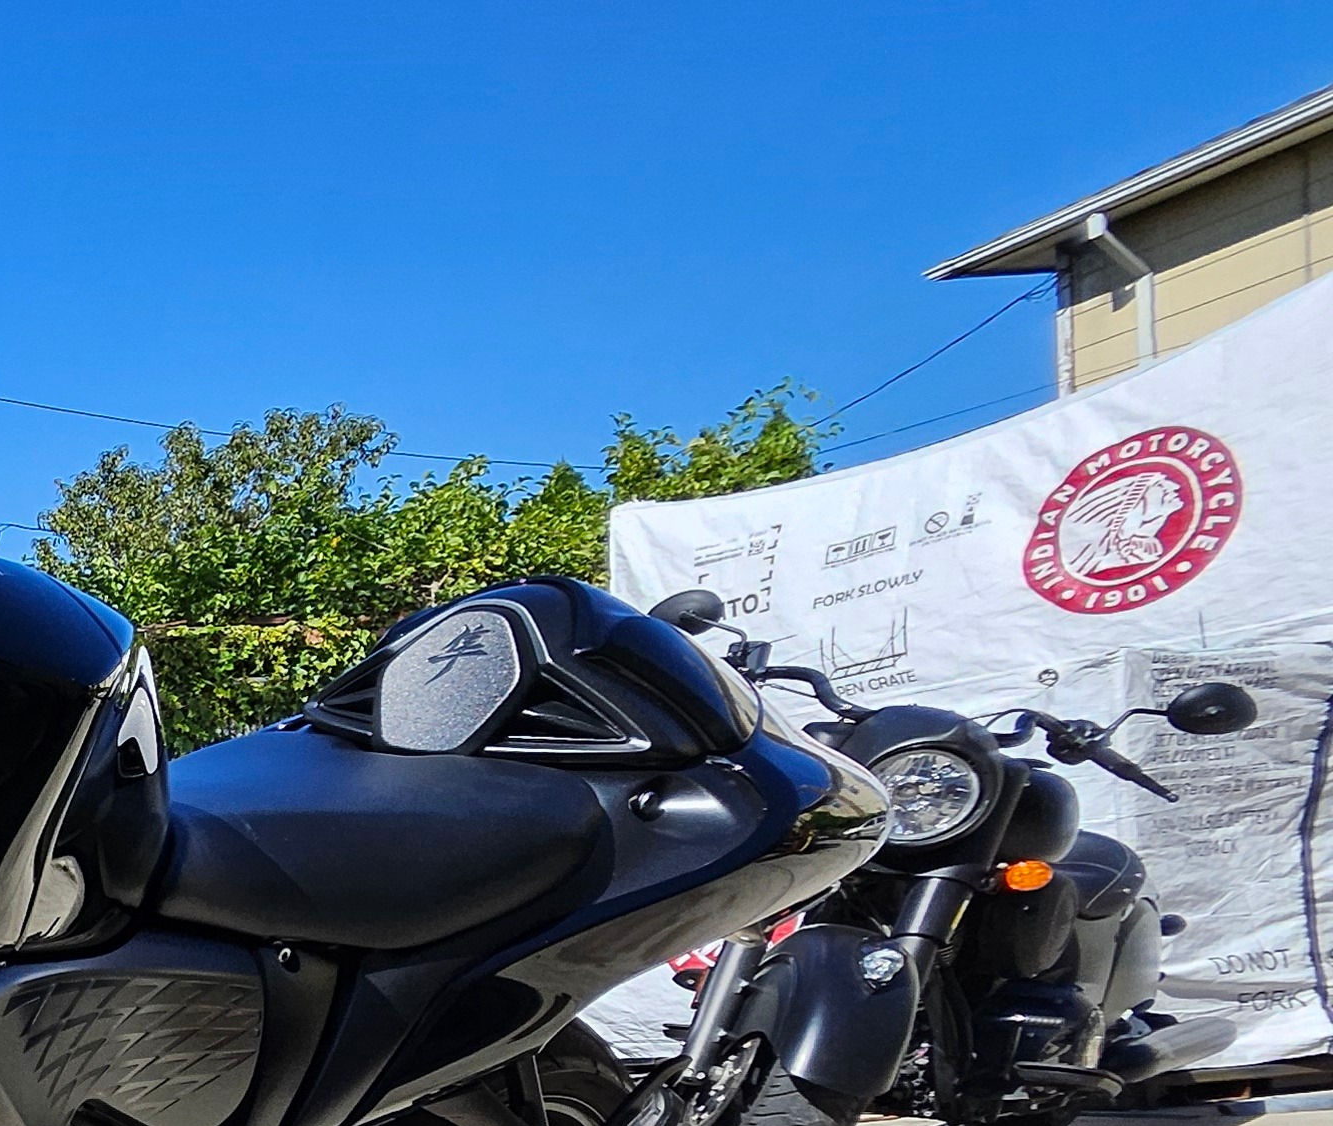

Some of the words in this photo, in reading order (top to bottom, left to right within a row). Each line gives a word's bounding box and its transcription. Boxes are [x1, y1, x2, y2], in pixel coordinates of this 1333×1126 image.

[1031, 484, 1077, 590] INDIAN
[1086, 433, 1236, 552] MOTORCYCLE
[812, 588, 855, 609] FORK
[857, 569, 924, 598] SLOWLY
[1085, 575, 1169, 608] 1901
[836, 682, 865, 697] PEN
[868, 670, 918, 691] CRATE
[1208, 954, 1245, 975] DO
[1245, 948, 1290, 973] NOT
[1237, 990, 1308, 1012] FORK
